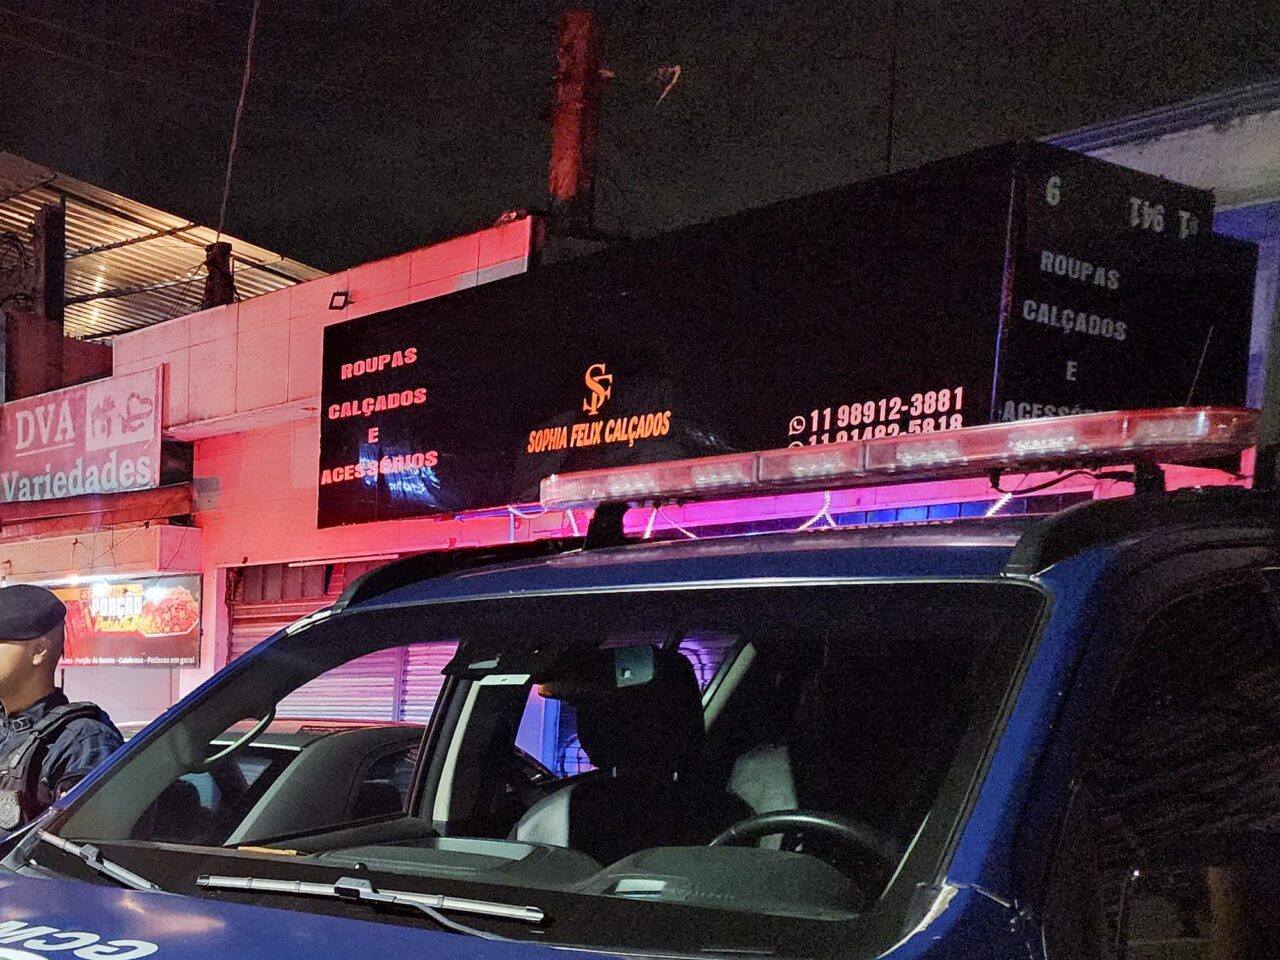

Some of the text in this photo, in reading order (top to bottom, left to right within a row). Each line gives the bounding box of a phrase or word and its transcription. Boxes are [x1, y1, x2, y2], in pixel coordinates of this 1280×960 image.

[1040, 251, 1120, 290] ROUPAS
[1023, 300, 1127, 341] CALÇADOS
[341, 347, 418, 380] ROUPAS
[1066, 361, 1078, 381] E
[328, 388, 427, 420] CALÇADOS
[810, 386, 964, 432] 11 98912-3881
[15, 399, 76, 450] DVA
[368, 427, 379, 443] E
[527, 410, 672, 453] SOPHIA FELIX CALÇADOS
[0, 450, 152, 501] Variedades
[320, 451, 439, 485] ACESSÓRIOS
